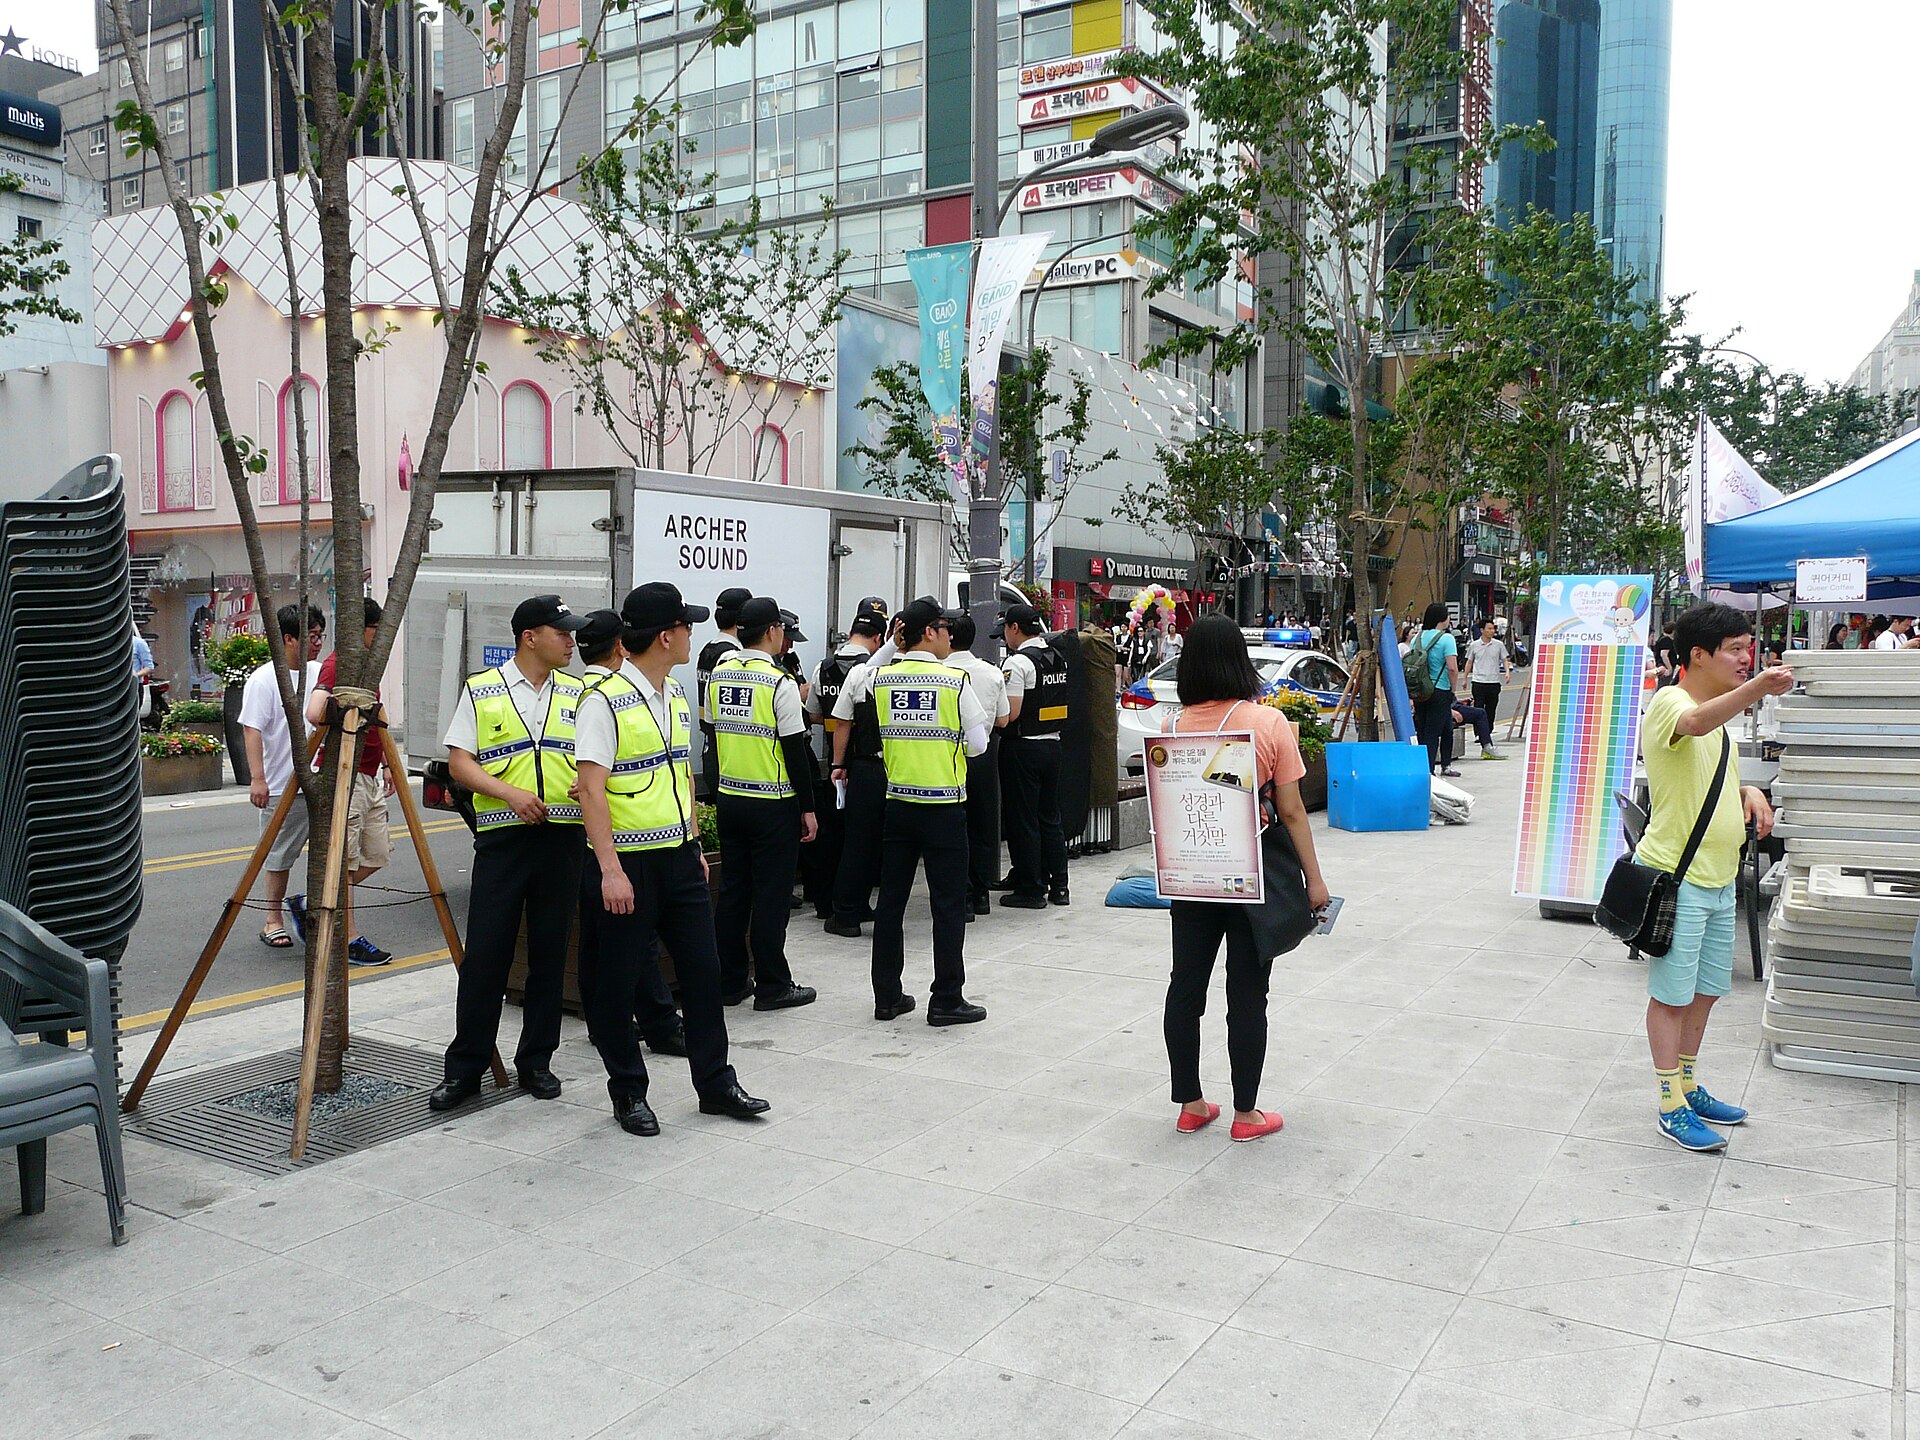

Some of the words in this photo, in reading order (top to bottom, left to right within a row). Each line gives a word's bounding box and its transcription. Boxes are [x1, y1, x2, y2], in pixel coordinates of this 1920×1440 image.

[8, 106, 45, 127] Multis
[1094, 257, 1117, 276] PC
[664, 514, 747, 542] ARCHER
[679, 544, 748, 571] SOUND
[1117, 562, 1143, 578] WORLD
[1143, 566, 1151, 579] &
[1811, 573, 1852, 583] 퀴어커피
[1580, 632, 1603, 642] CMS
[1042, 673, 1067, 685] POLICE
[720, 686, 751, 706] 경찰
[822, 685, 840, 696] POL
[893, 691, 934, 709] 경찰
[720, 707, 750, 717] POLICE
[893, 713, 933, 721] POLICE
[479, 746, 516, 760] OLICE
[616, 758, 659, 771] OLICE
[897, 787, 932, 796] POLICE
[1179, 792, 1225, 812] 성경과
[1187, 810, 1218, 829] 다른
[1182, 827, 1228, 847] 거짓말
